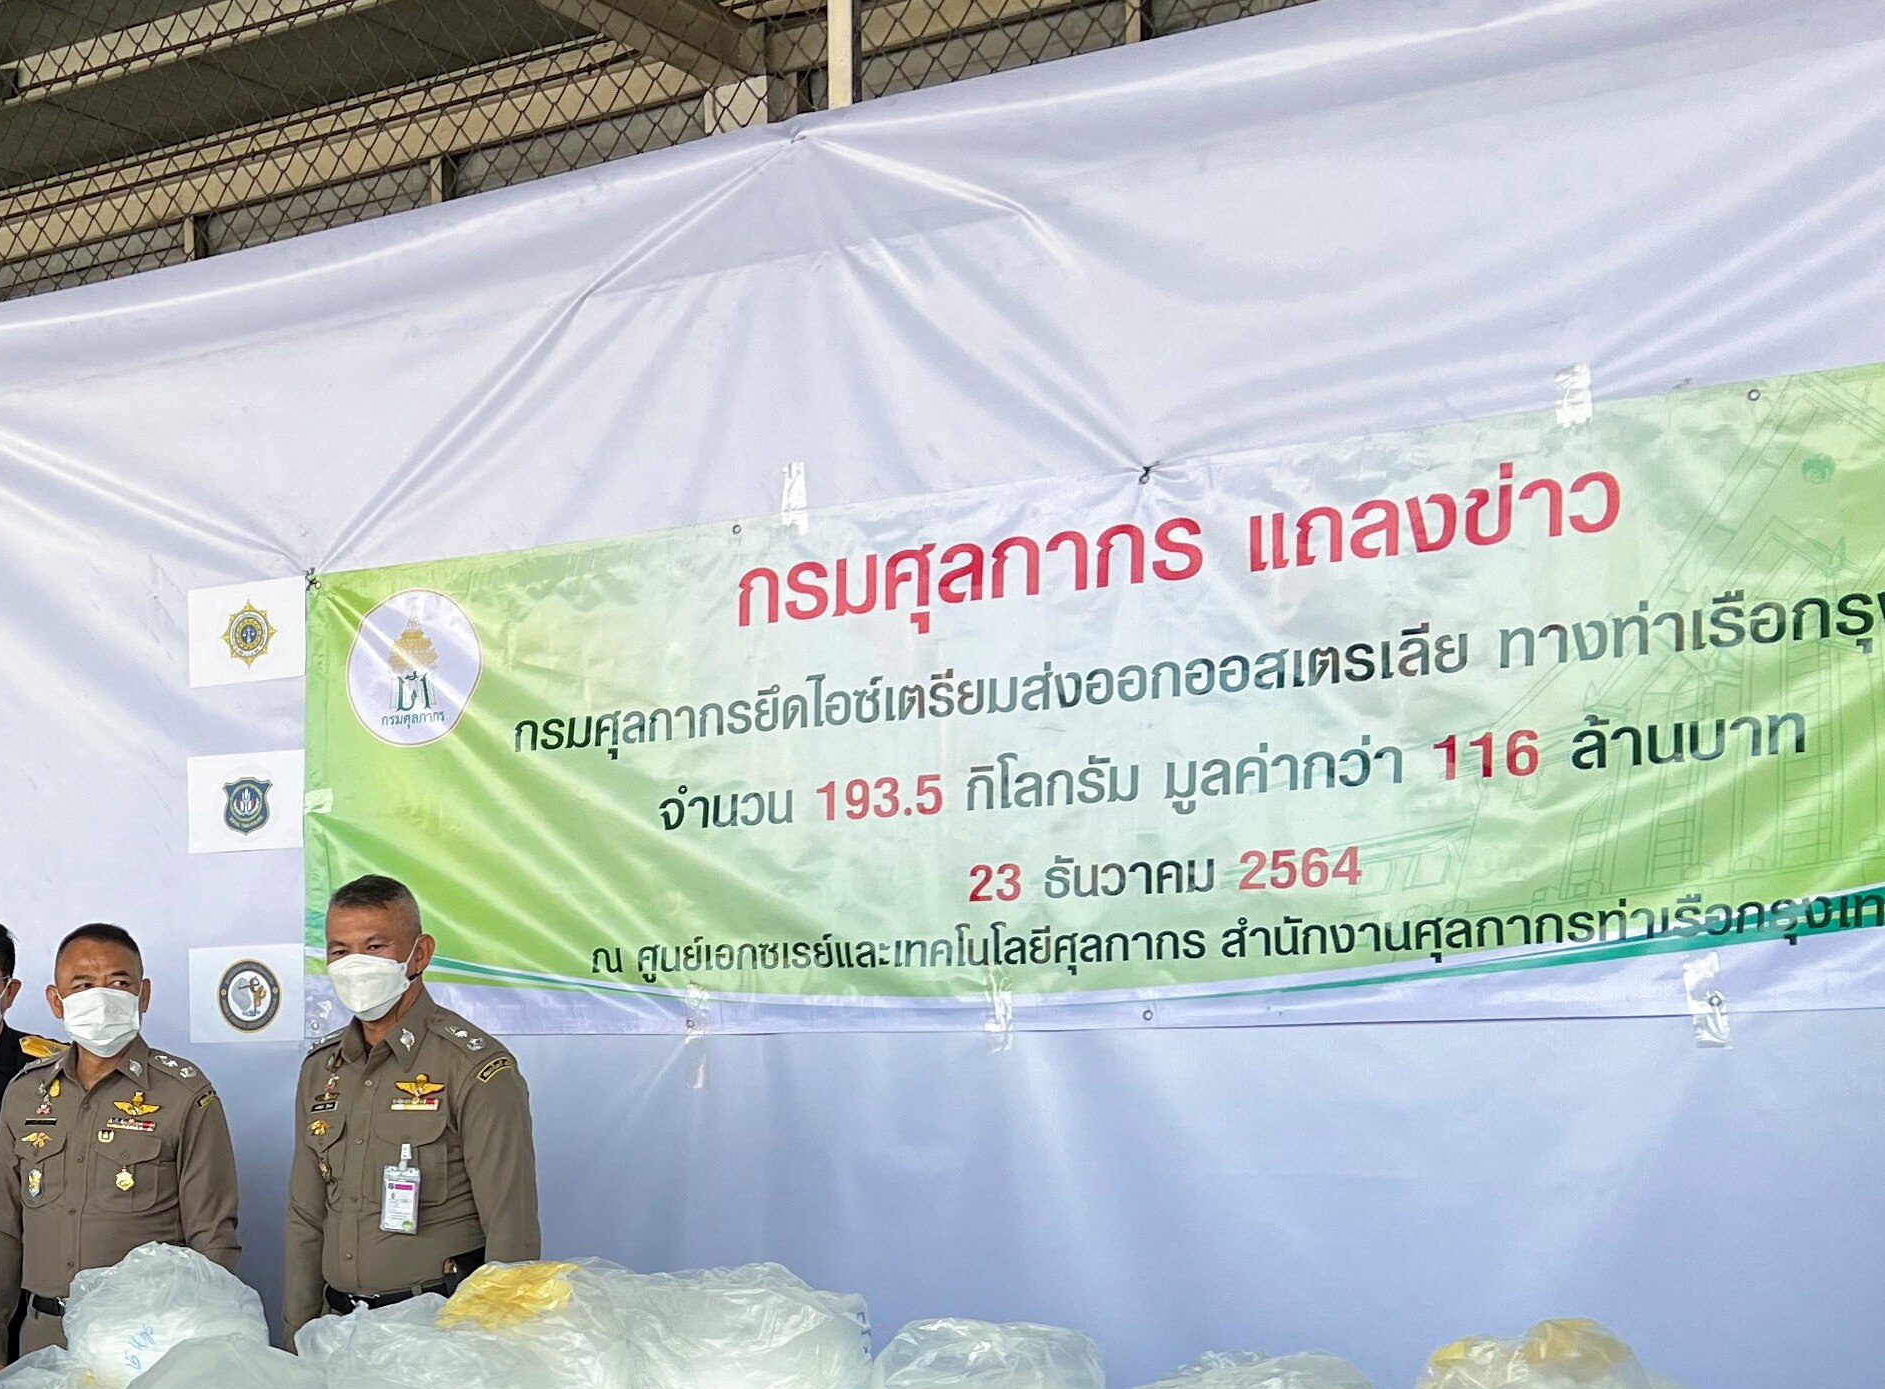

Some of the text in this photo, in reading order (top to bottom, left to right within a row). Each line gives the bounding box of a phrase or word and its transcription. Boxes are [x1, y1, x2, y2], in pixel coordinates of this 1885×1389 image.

[737, 460, 1622, 634] กรมศุลกากร แถลงข่าว
[381, 711, 445, 729] กรมศุลกากร
[513, 621, 1469, 760] กรมศุลกากรยึดไอซ์เตรียมส่งออกออสเตรเลีย
[659, 711, 1807, 830] จำนวน 193.5 กิโลกรัม มูลค่ากว่า 116 ล้านบาท
[968, 844, 1362, 903] 23 ธันวาคม 2564
[592, 945, 624, 975] ณ
[636, 925, 1207, 985] ศูนย์เอกซเรย์และเทคโนโลยีศุลกากร
